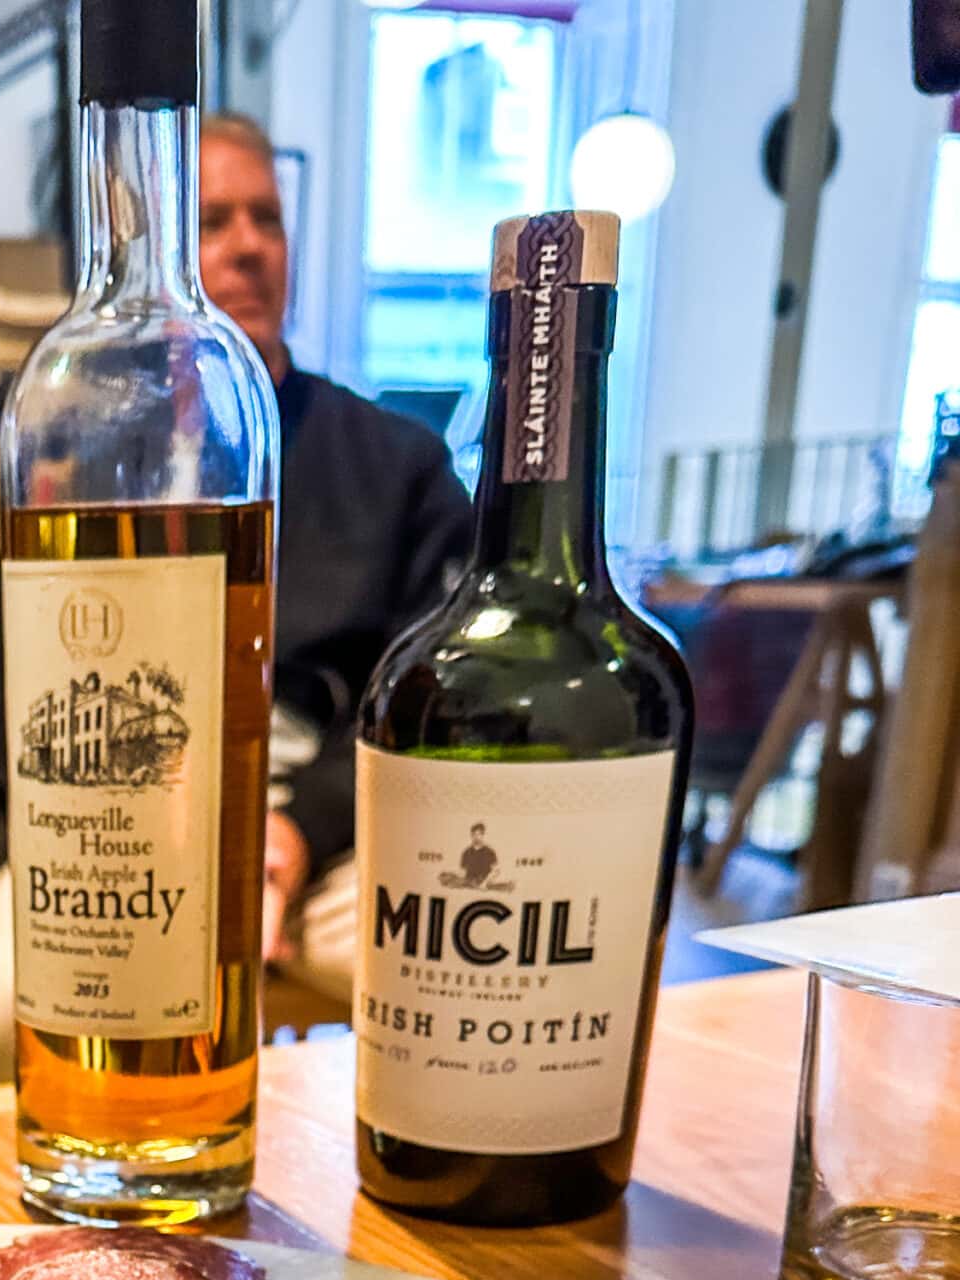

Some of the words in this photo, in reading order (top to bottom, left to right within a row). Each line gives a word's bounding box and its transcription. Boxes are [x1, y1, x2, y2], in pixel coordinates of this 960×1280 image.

[524, 352, 549, 465] SLÁINTE
[28, 802, 134, 837] Longueville
[80, 833, 153, 856] House
[51, 860, 83, 880] Irish
[87, 863, 137, 888] Apple
[28, 864, 185, 935] Brandy
[374, 884, 595, 967] MICIL
[400, 964, 549, 990] DISTILLERY
[458, 1011, 611, 1045] POITÍN
